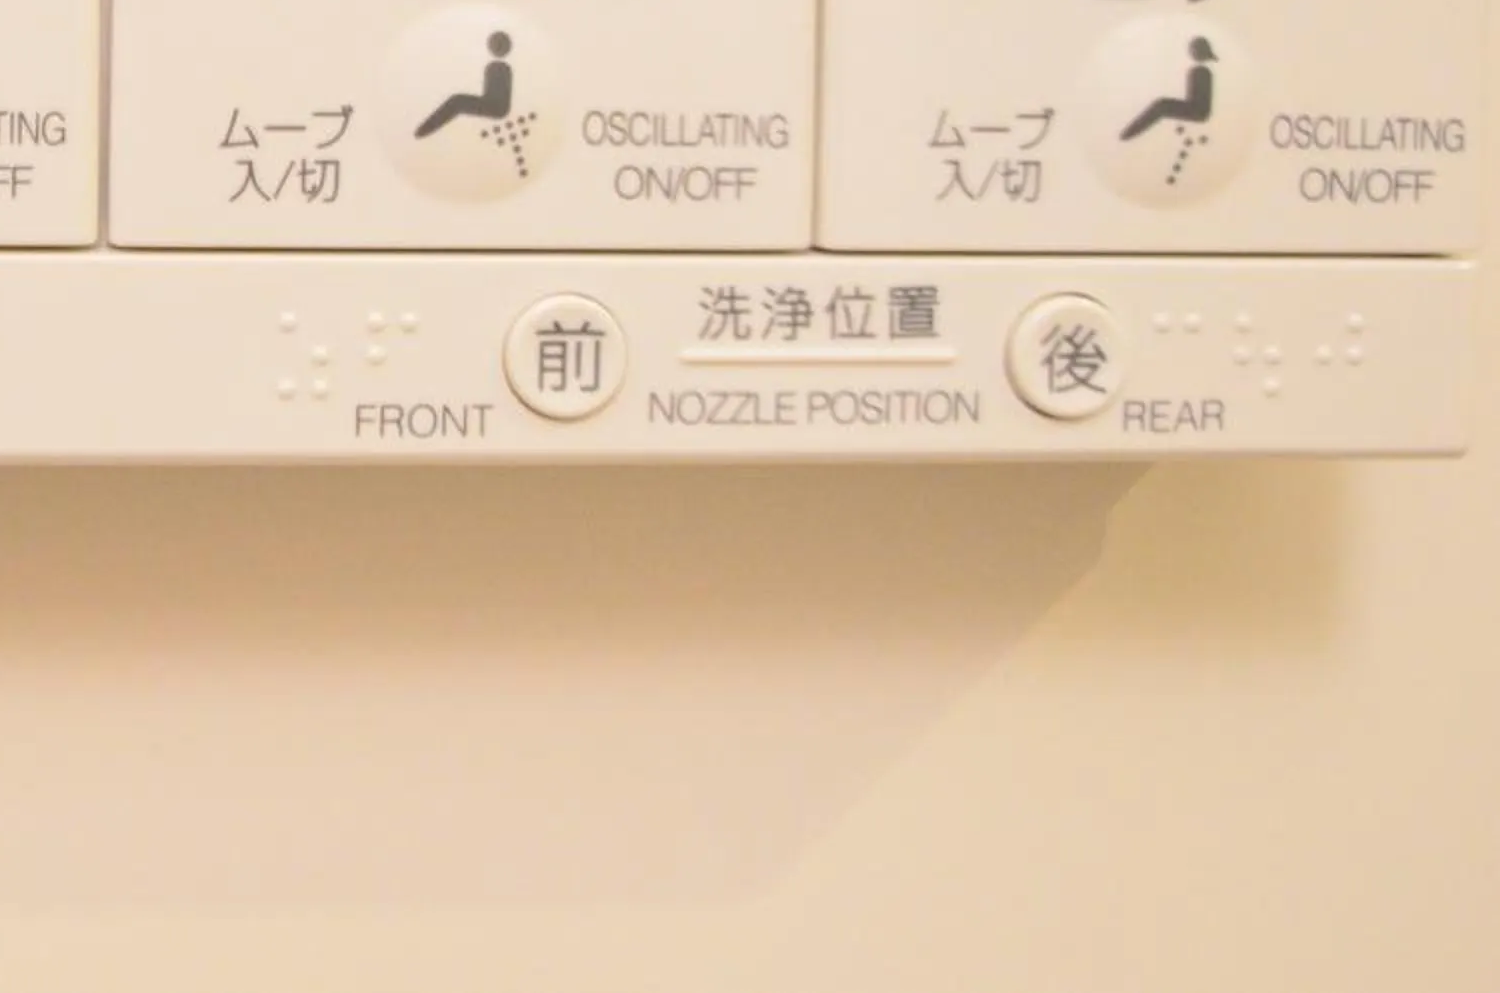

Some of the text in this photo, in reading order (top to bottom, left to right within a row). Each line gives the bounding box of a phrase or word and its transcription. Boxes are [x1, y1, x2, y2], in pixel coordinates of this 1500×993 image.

[218, 104, 355, 150] ムーブ
[582, 110, 789, 149] OSCILLATING
[928, 106, 1056, 150] ムーブ
[1270, 114, 1465, 153] OSCILLATING
[614, 165, 757, 202] ON/OFF
[1299, 167, 1433, 204] ON/OFF
[698, 285, 941, 341] 洗浄位置
[534, 320, 607, 393] 前
[1040, 323, 1108, 395] 後
[355, 403, 493, 437] FRONT
[648, 390, 980, 425] NOZZLE POSITION
[1122, 399, 1226, 433] REAR
